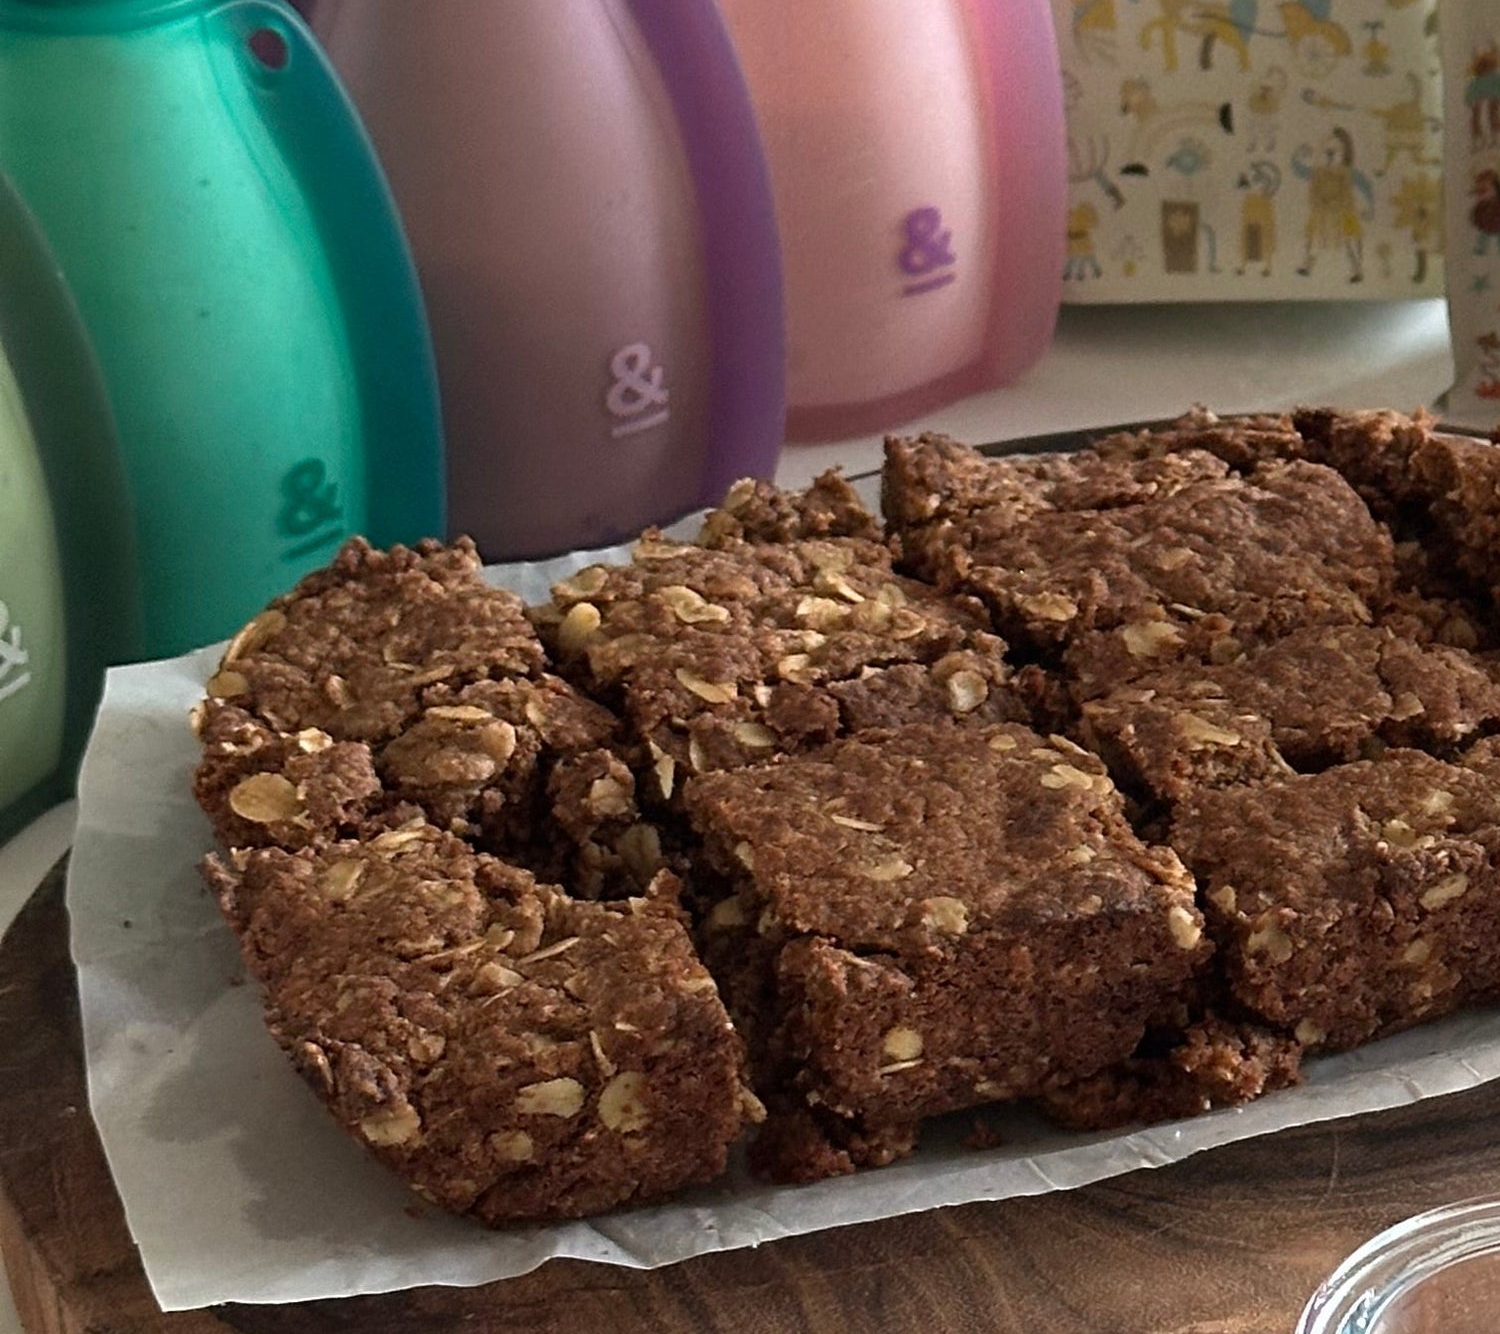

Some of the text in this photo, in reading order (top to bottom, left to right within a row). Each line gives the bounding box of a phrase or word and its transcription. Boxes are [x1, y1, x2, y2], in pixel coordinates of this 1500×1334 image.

[898, 207, 956, 278] &
[607, 343, 670, 416] &
[278, 457, 342, 539] &
